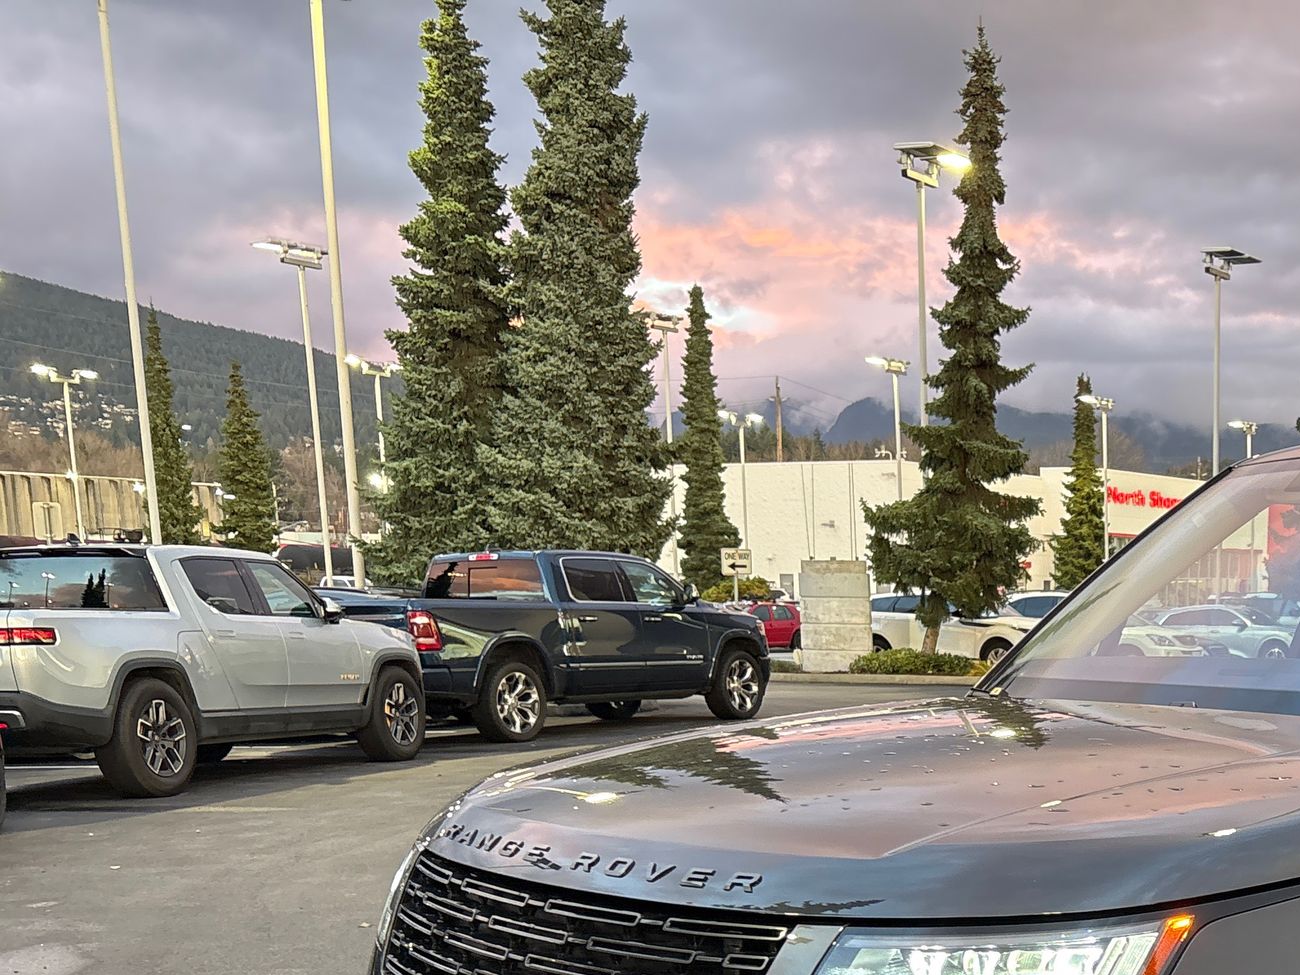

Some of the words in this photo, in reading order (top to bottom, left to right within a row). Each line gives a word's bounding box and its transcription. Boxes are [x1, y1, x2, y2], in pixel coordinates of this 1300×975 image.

[1107, 486, 1145, 507] North
[725, 552, 736, 560] ONE
[739, 552, 750, 560] WAY
[446, 824, 551, 862] RANGE
[569, 851, 763, 894] ROVER
